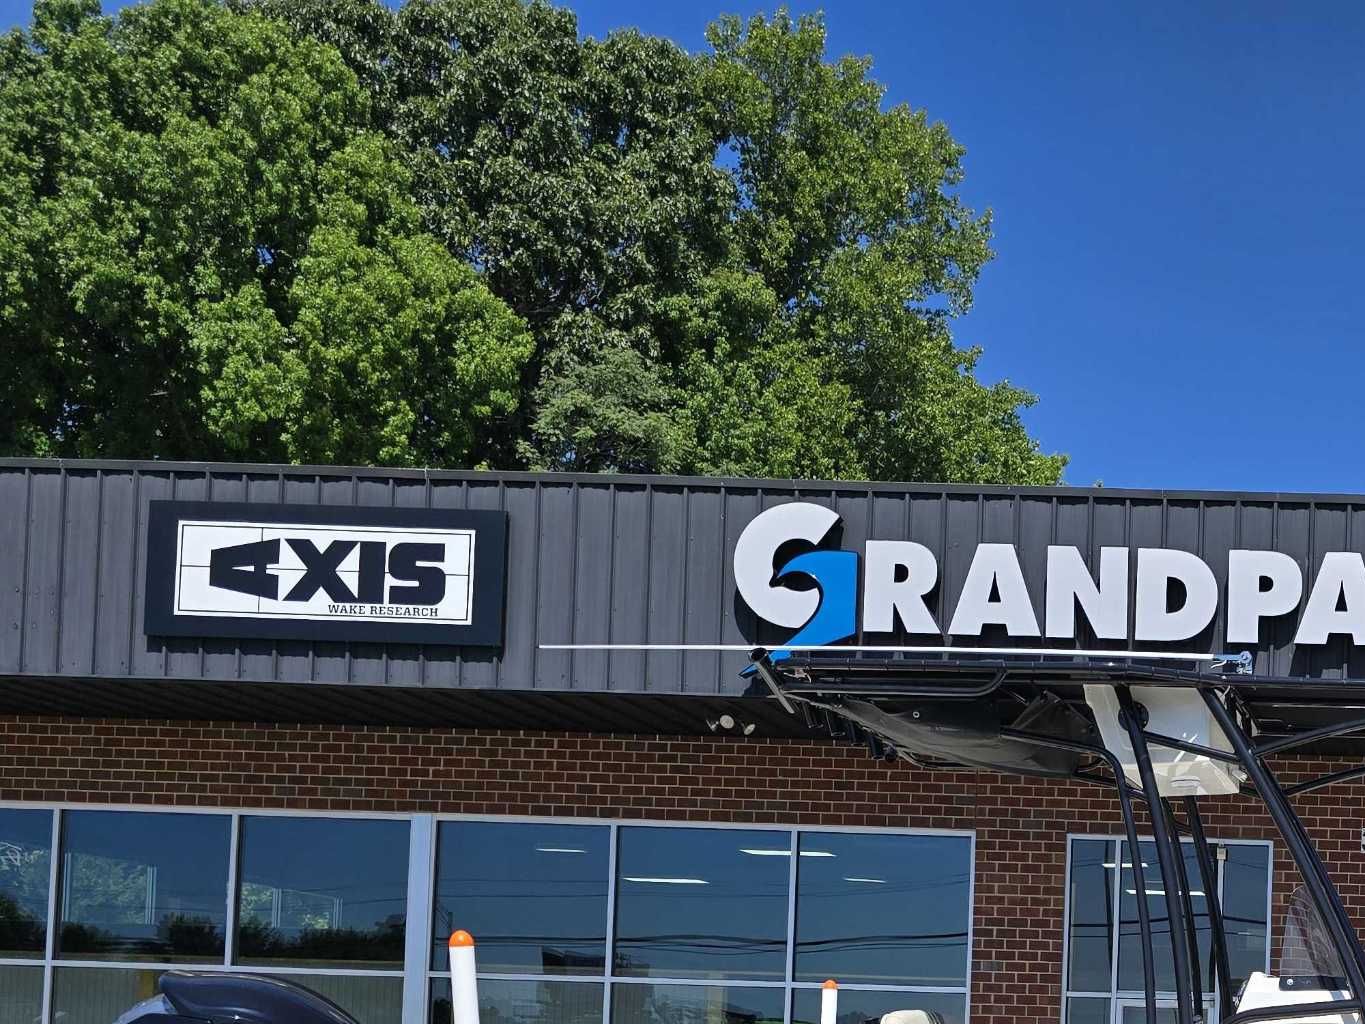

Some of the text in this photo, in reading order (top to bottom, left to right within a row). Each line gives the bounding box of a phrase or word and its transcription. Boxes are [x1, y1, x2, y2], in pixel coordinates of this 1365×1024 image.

[209, 537, 447, 606] AXIS
[327, 604, 439, 617] WAKE RESEARCH
